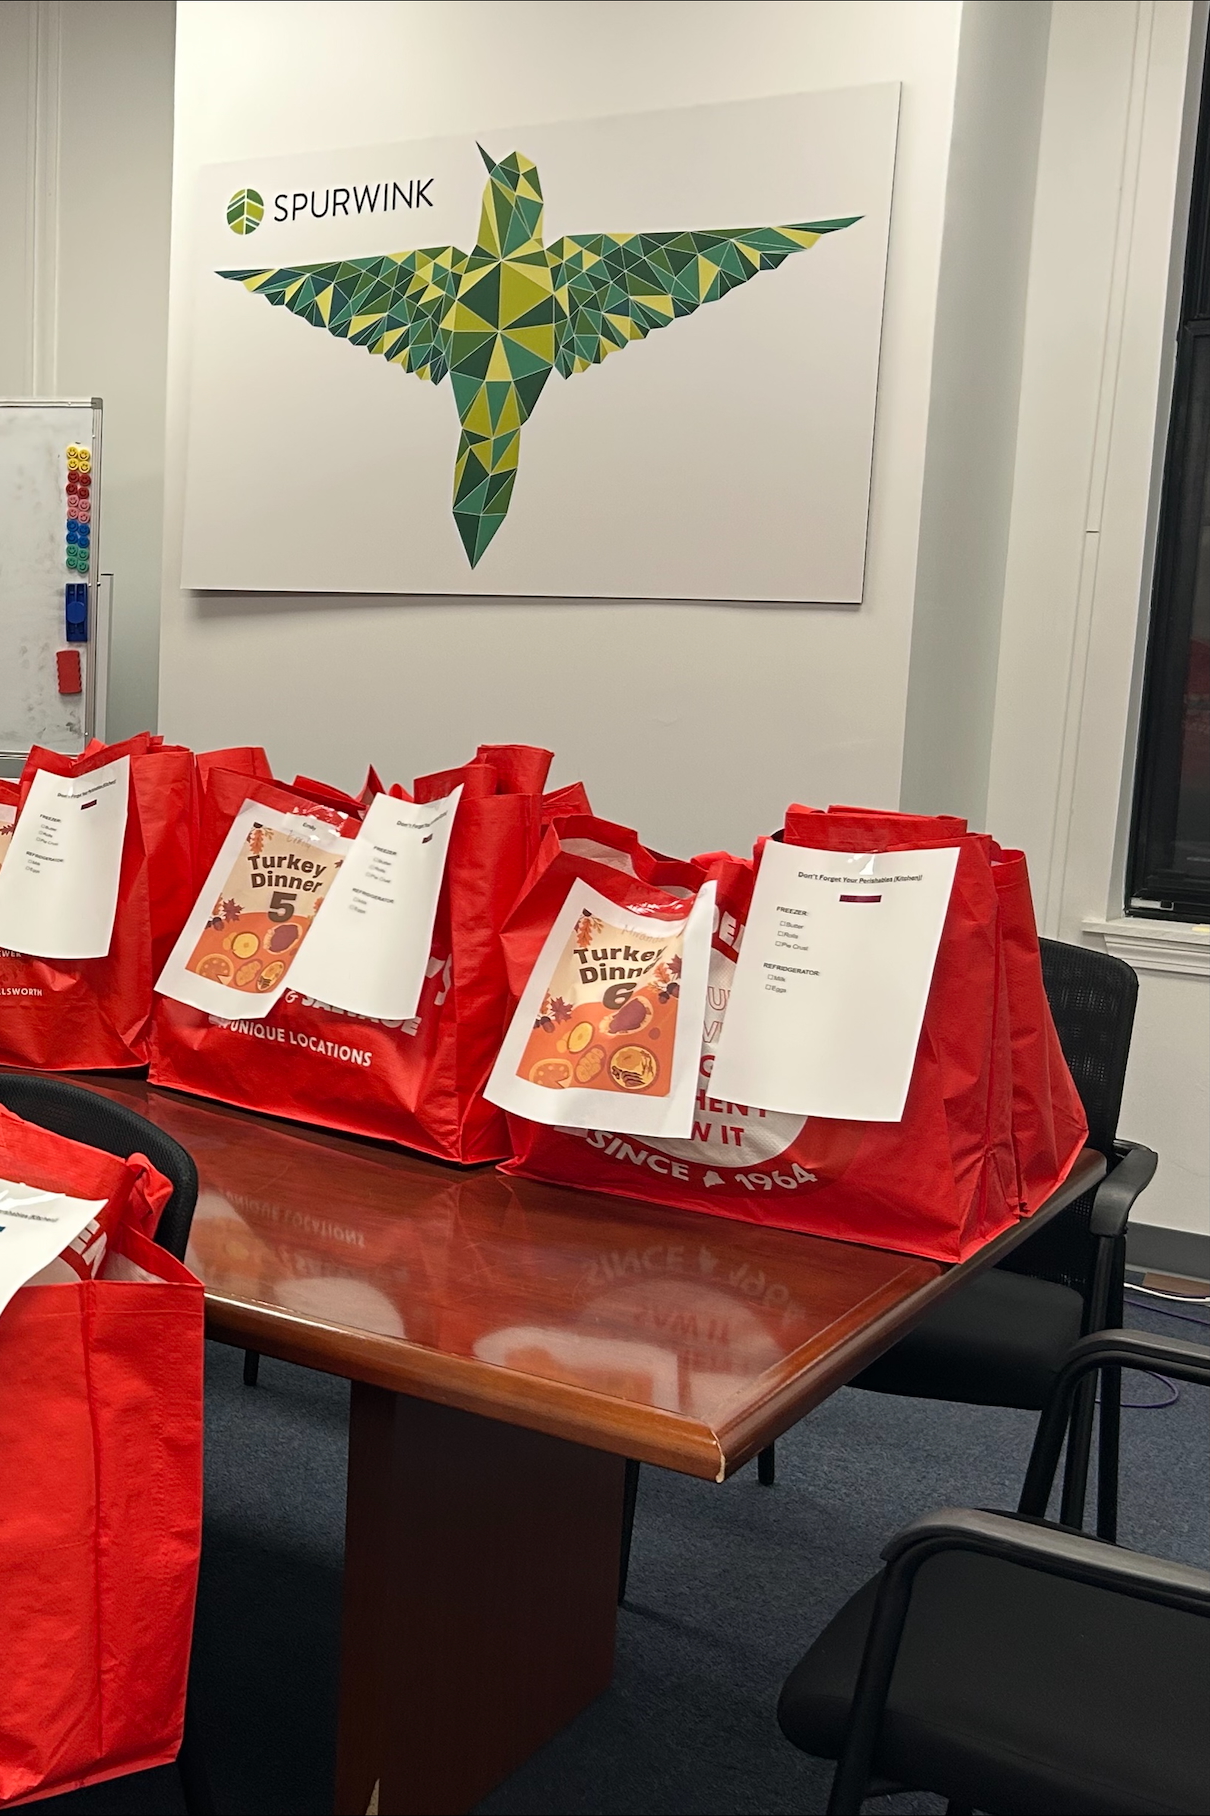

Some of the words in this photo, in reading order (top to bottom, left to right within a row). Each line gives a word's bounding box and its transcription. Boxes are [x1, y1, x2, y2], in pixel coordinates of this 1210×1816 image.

[273, 178, 434, 222] SPURWINK
[247, 853, 328, 878] Turkey
[797, 871, 819, 881] Don't
[819, 874, 841, 883] Forget
[250, 870, 324, 894] Dinner
[267, 890, 298, 923] 5
[776, 906, 809, 917] FREEZER:
[602, 982, 637, 1010] 6
[230, 1019, 285, 1043] UNIQUE
[289, 1030, 373, 1068] LOCATIONS
[721, 1125, 745, 1147] IT
[585, 1130, 690, 1182] SINCE
[734, 1163, 819, 1191] 1964
